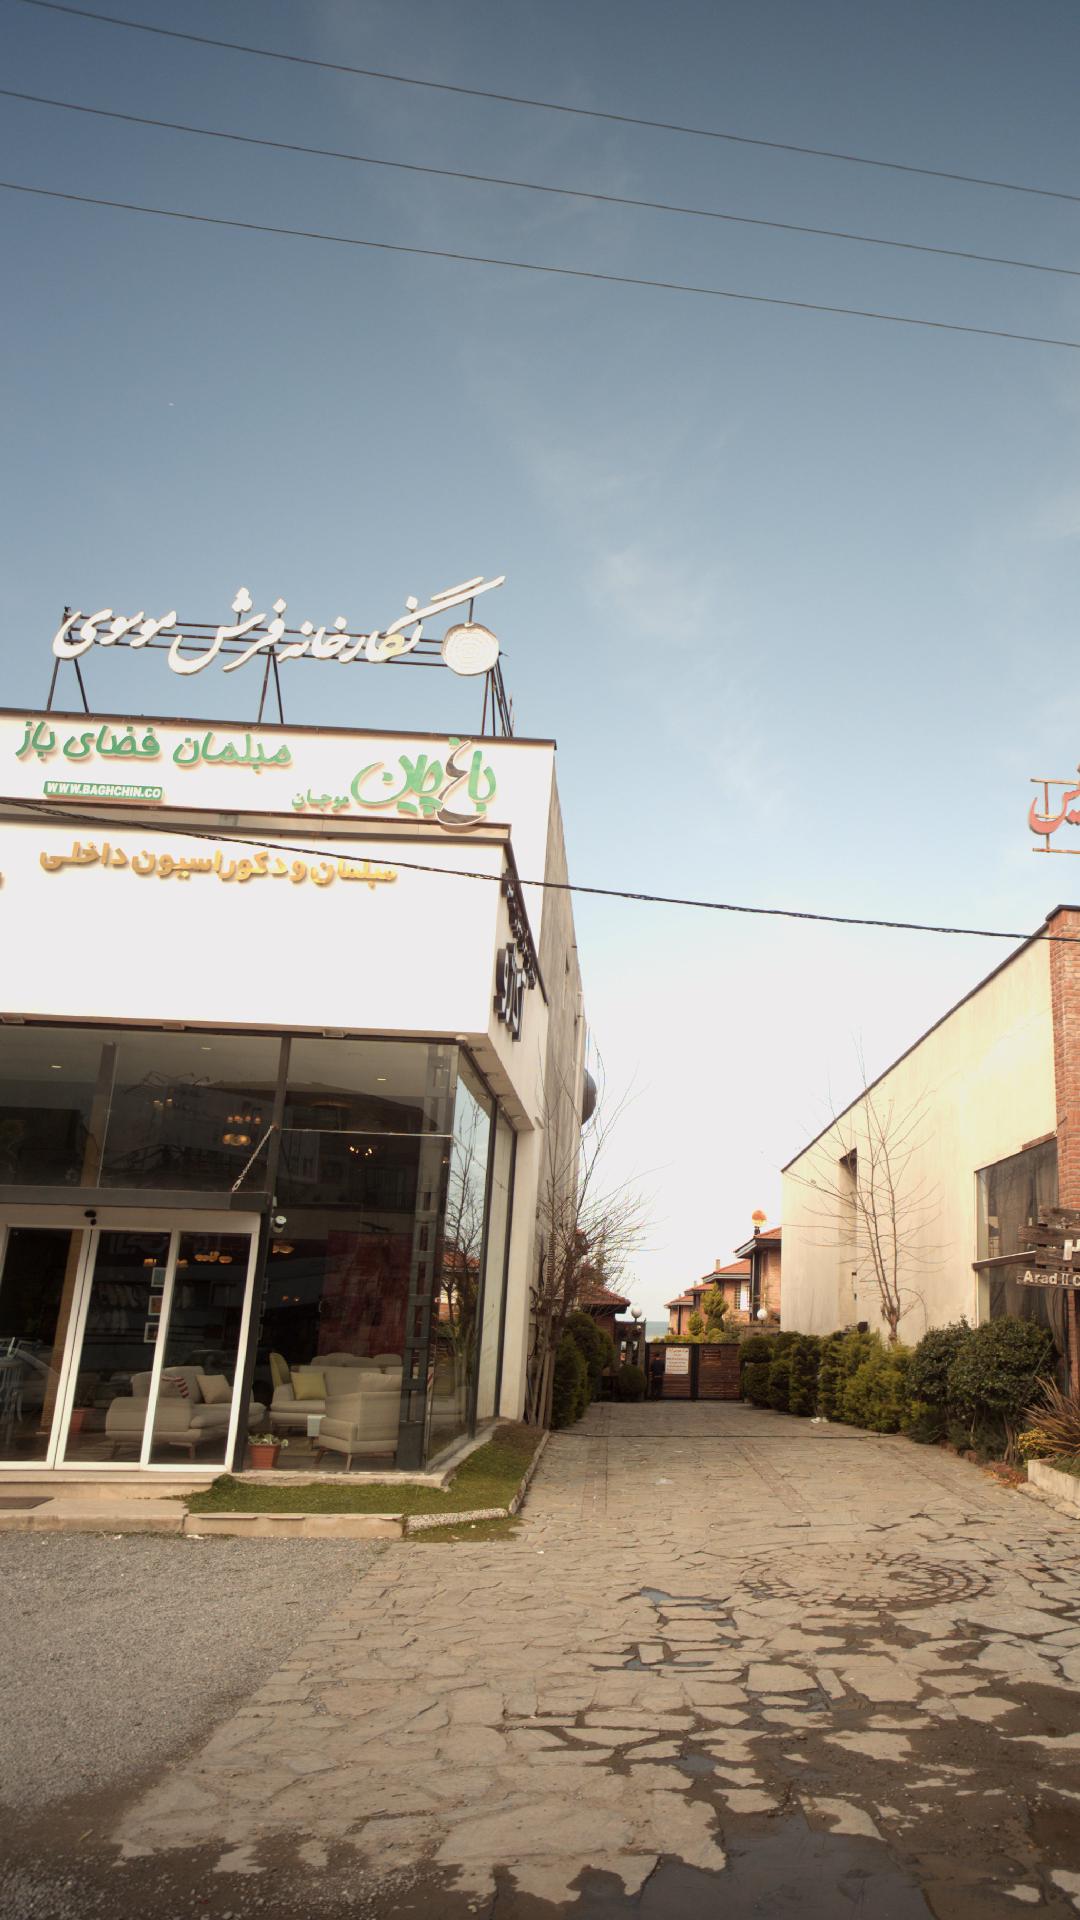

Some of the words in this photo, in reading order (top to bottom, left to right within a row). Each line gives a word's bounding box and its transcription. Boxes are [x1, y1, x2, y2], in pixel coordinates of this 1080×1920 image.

[52, 608, 177, 660] موسوی
[168, 587, 287, 676] فرش
[277, 575, 505, 664] نگارخانه
[16, 721, 55, 758] باز
[63, 725, 160, 758] فضای
[172, 731, 292, 773] مبلمان
[46, 781, 162, 799] WWW.BAGHCHIN.CO
[39, 841, 128, 870] داخلی
[131, 849, 288, 881] دکوراسیون
[289, 860, 307, 882] و
[310, 857, 398, 888] مبلمان
[1023, 1270, 1057, 1285] Arad
